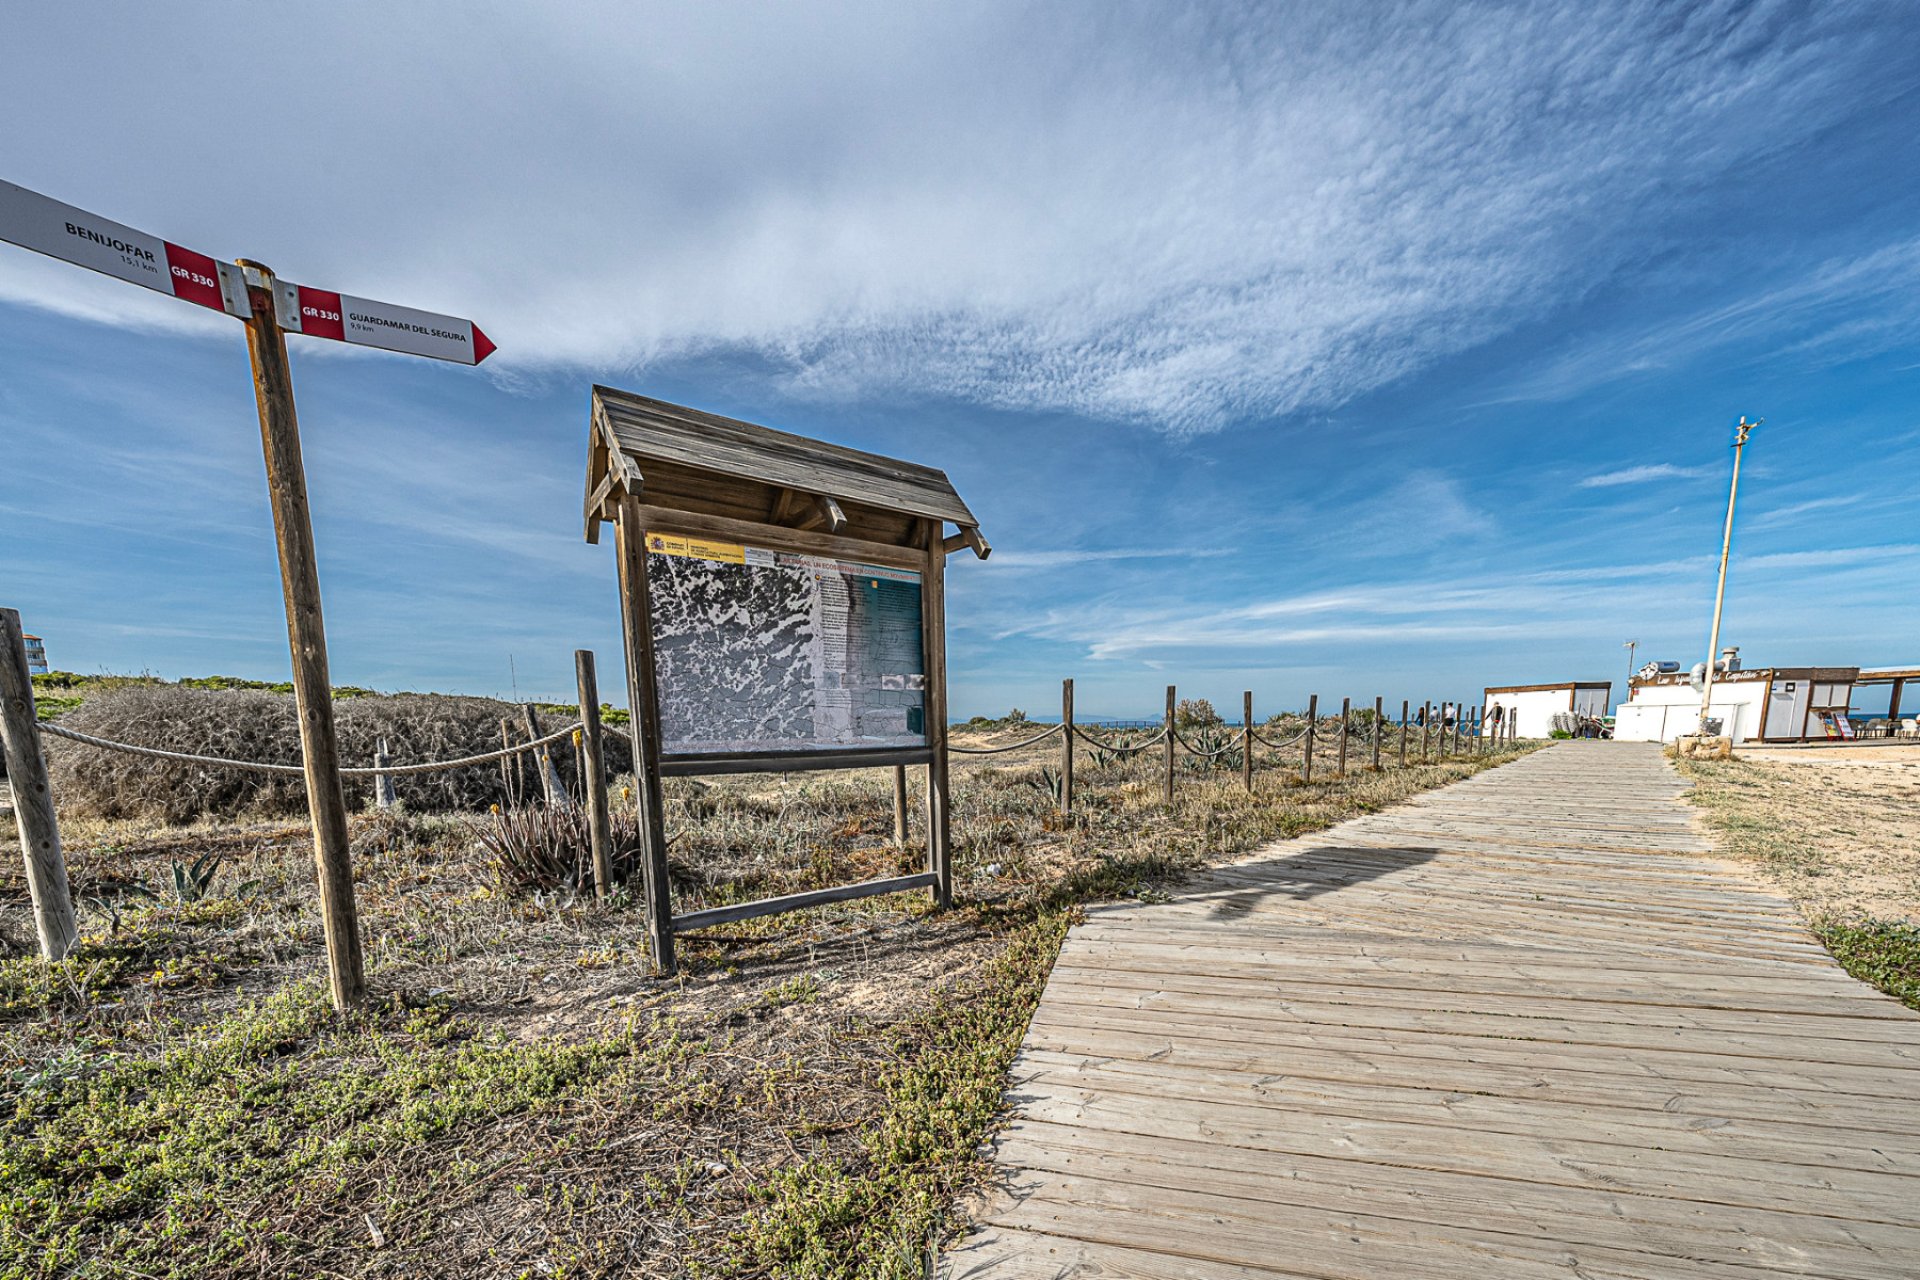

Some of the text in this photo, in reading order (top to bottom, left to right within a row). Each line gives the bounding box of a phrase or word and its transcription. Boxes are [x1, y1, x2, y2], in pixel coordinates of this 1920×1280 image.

[65, 222, 155, 263] BENIJOFAR
[121, 255, 158, 274] 15,1 km
[171, 265, 214, 288] GR 330
[302, 306, 340, 321] GR 330
[349, 312, 467, 343] GUARDAMAR DEL SEGURA
[350, 321, 375, 333] 9,9 km
